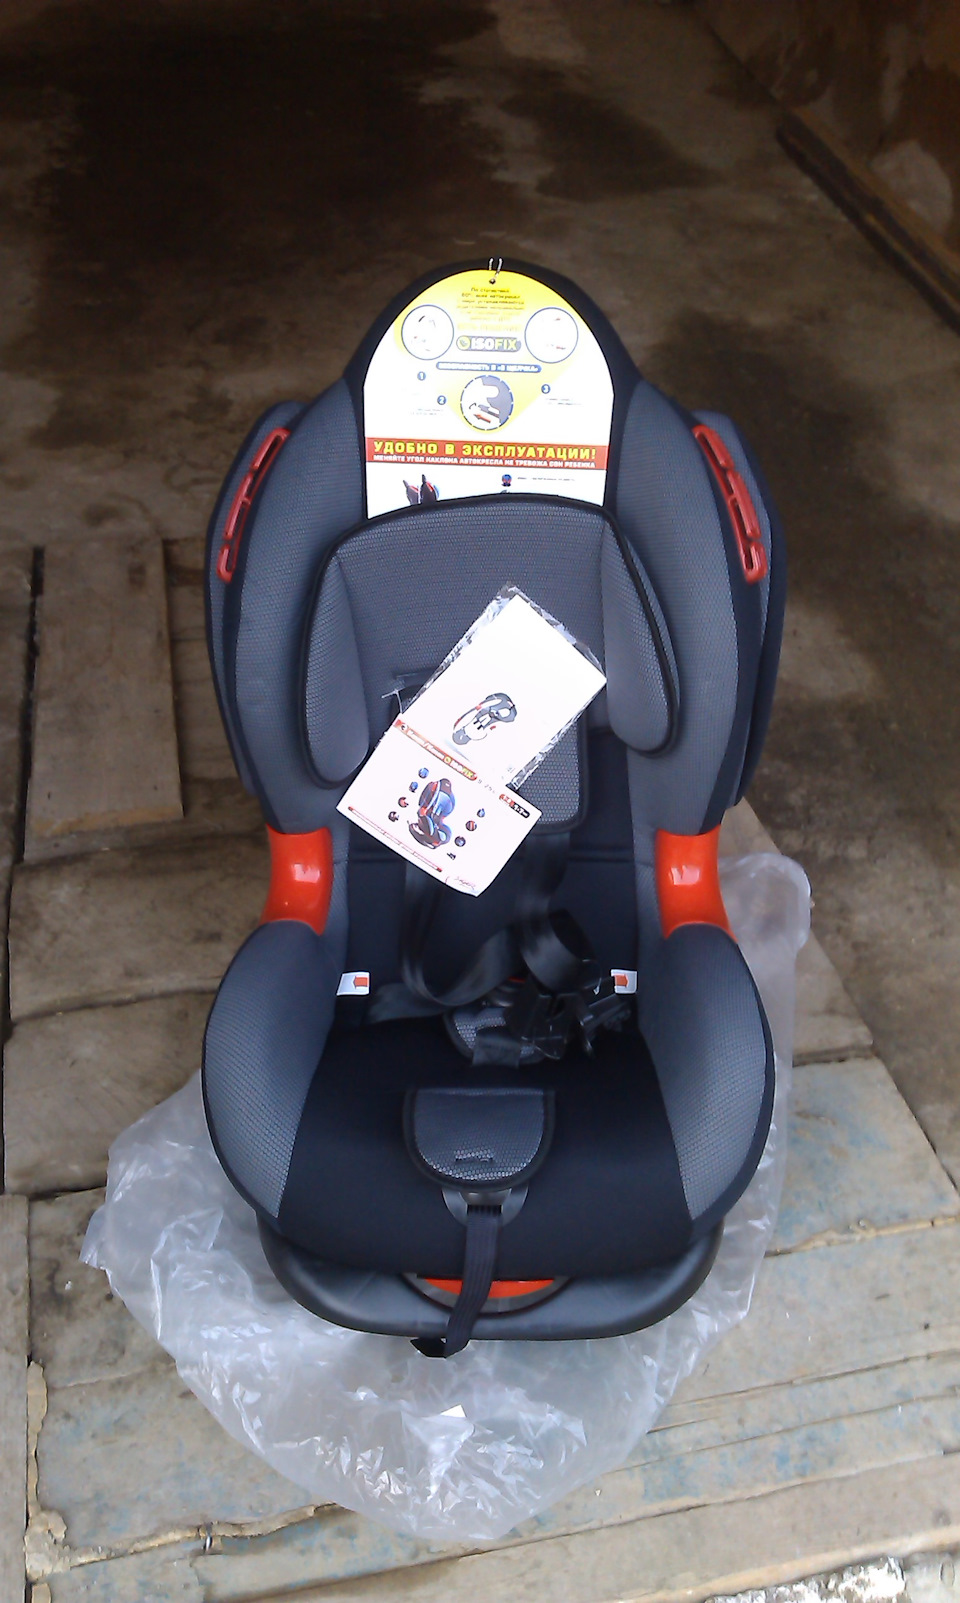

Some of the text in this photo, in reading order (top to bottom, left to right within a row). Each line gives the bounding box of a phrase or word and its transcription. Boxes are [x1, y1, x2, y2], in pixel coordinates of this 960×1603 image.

[470, 337, 517, 350] ISOFIX
[373, 441, 597, 460] УДОБНО В ЭКСПЛУАТАЦИИ!
[373, 454, 405, 462] МЕНЯЙТЕ
[425, 456, 458, 464] НАКЛОНА
[515, 460, 549, 468] ТРЕВОЖА
